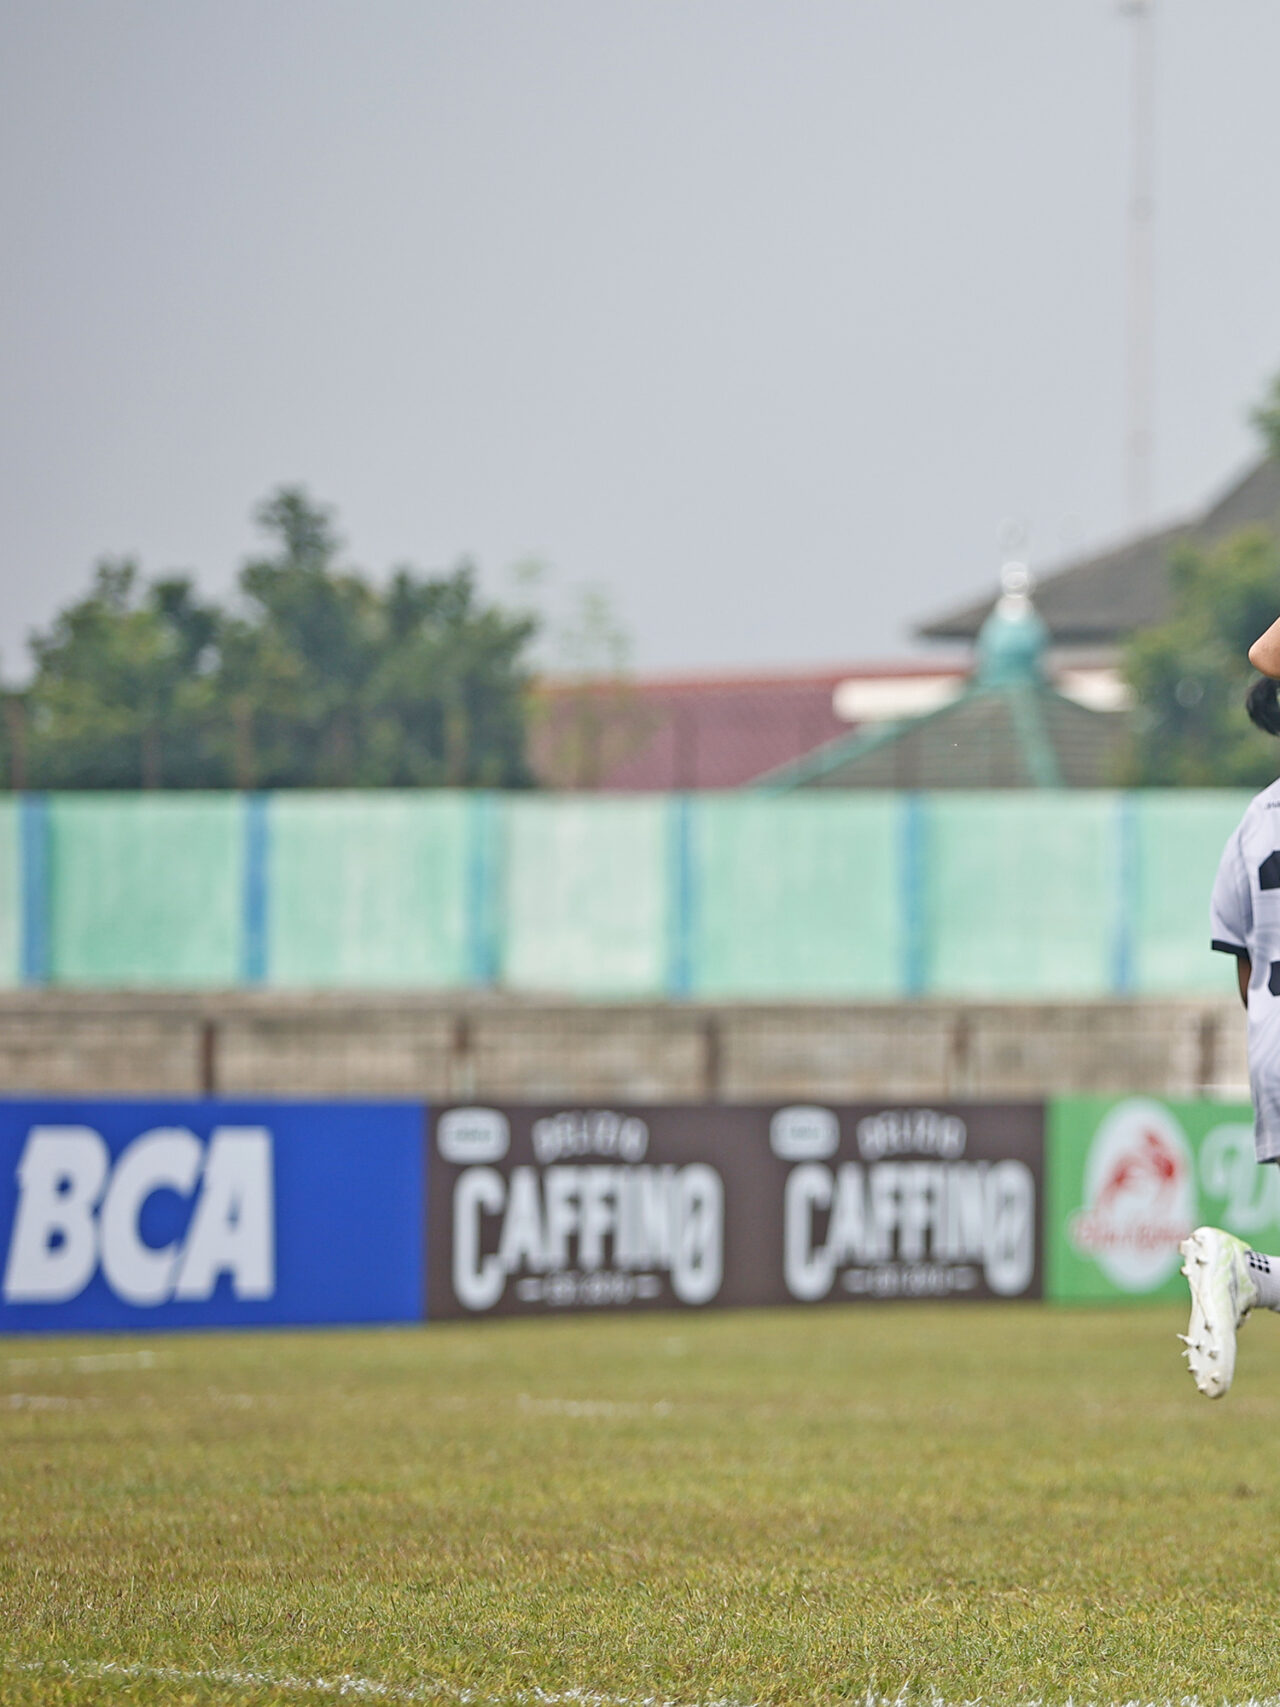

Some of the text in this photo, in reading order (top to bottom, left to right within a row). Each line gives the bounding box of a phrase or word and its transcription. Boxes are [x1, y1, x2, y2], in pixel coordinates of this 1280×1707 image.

[4, 1123, 275, 1307] BCA
[453, 1163, 724, 1310] CAFFINO
[784, 1160, 1035, 1300] CAFFINO
